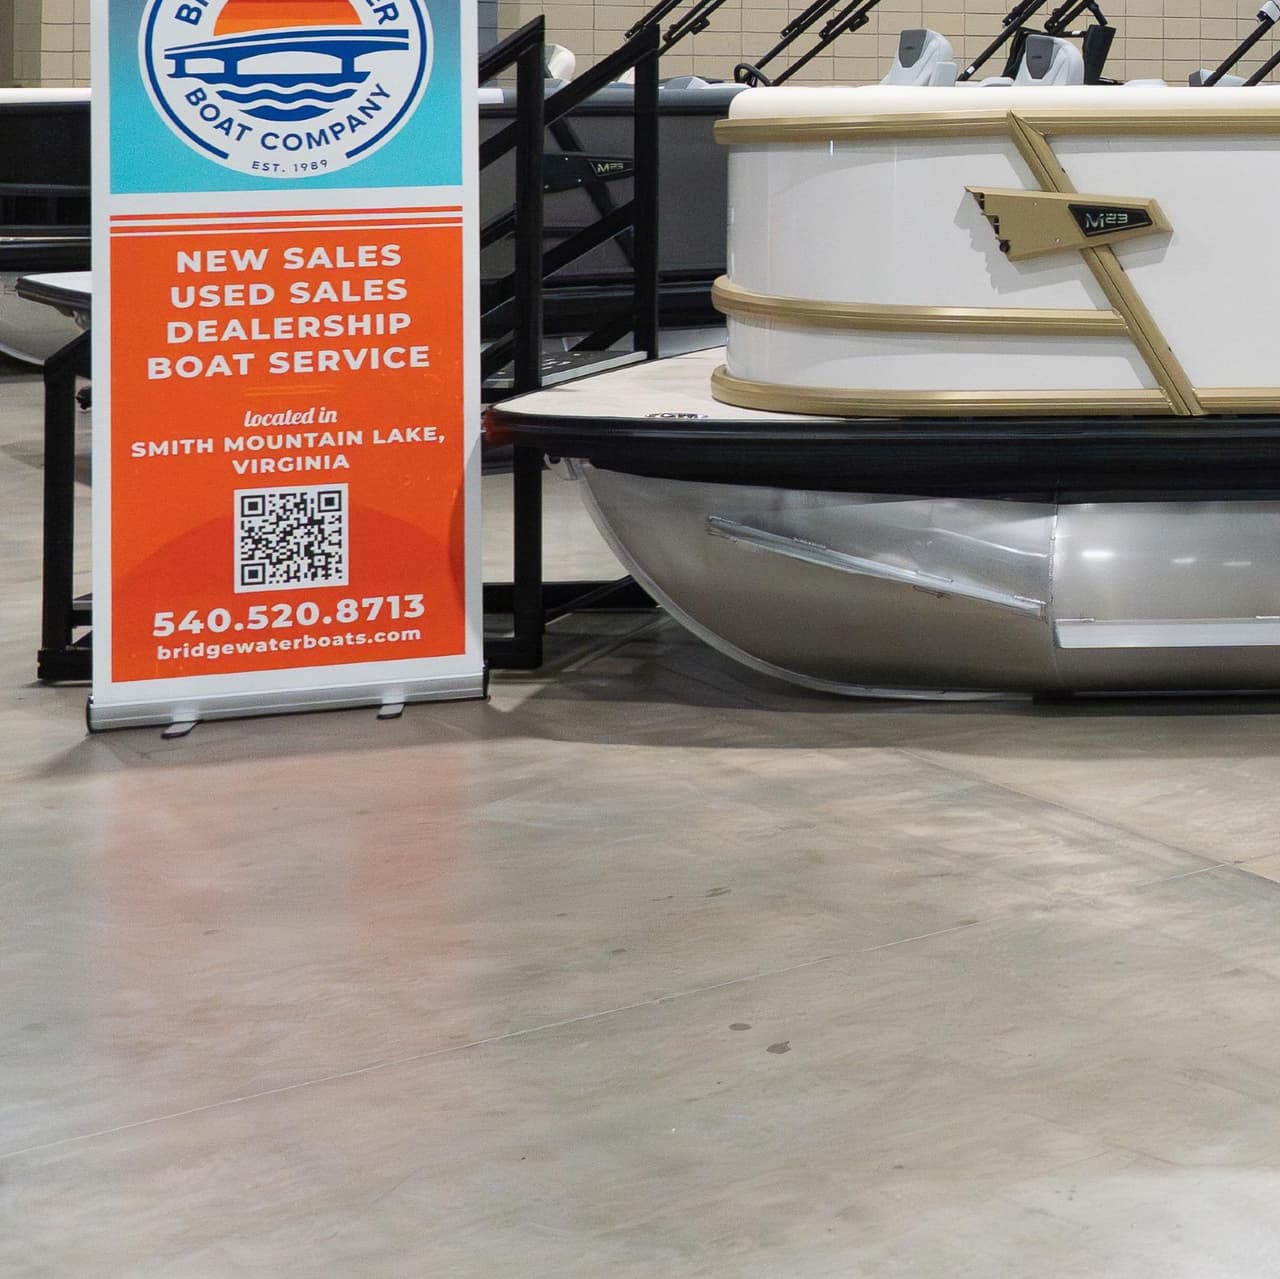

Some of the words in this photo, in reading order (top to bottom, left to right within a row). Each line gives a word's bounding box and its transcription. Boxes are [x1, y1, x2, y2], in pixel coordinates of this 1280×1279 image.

[184, 87, 253, 143] BOAT
[261, 83, 392, 152] COMPANY
[251, 161, 286, 173] EST.
[293, 159, 328, 173] 1989
[1085, 213, 1128, 228] M23
[176, 248, 270, 274] NEW
[283, 244, 402, 270] SALES
[170, 283, 275, 308] USED
[289, 278, 408, 304] SALES
[167, 313, 412, 344] DEALERSHIP
[147, 353, 256, 380] BOAT
[269, 345, 430, 375] SERVICE
[243, 407, 315, 428] located
[318, 406, 338, 425] in
[131, 437, 214, 458] SMITH
[224, 431, 363, 453] MOUNTAIN
[372, 426, 446, 445] LAKE,
[232, 455, 350, 475] VIRGINIA
[153, 594, 425, 637] 540.520.8713
[157, 627, 421, 661] bridgewaterboats.com
